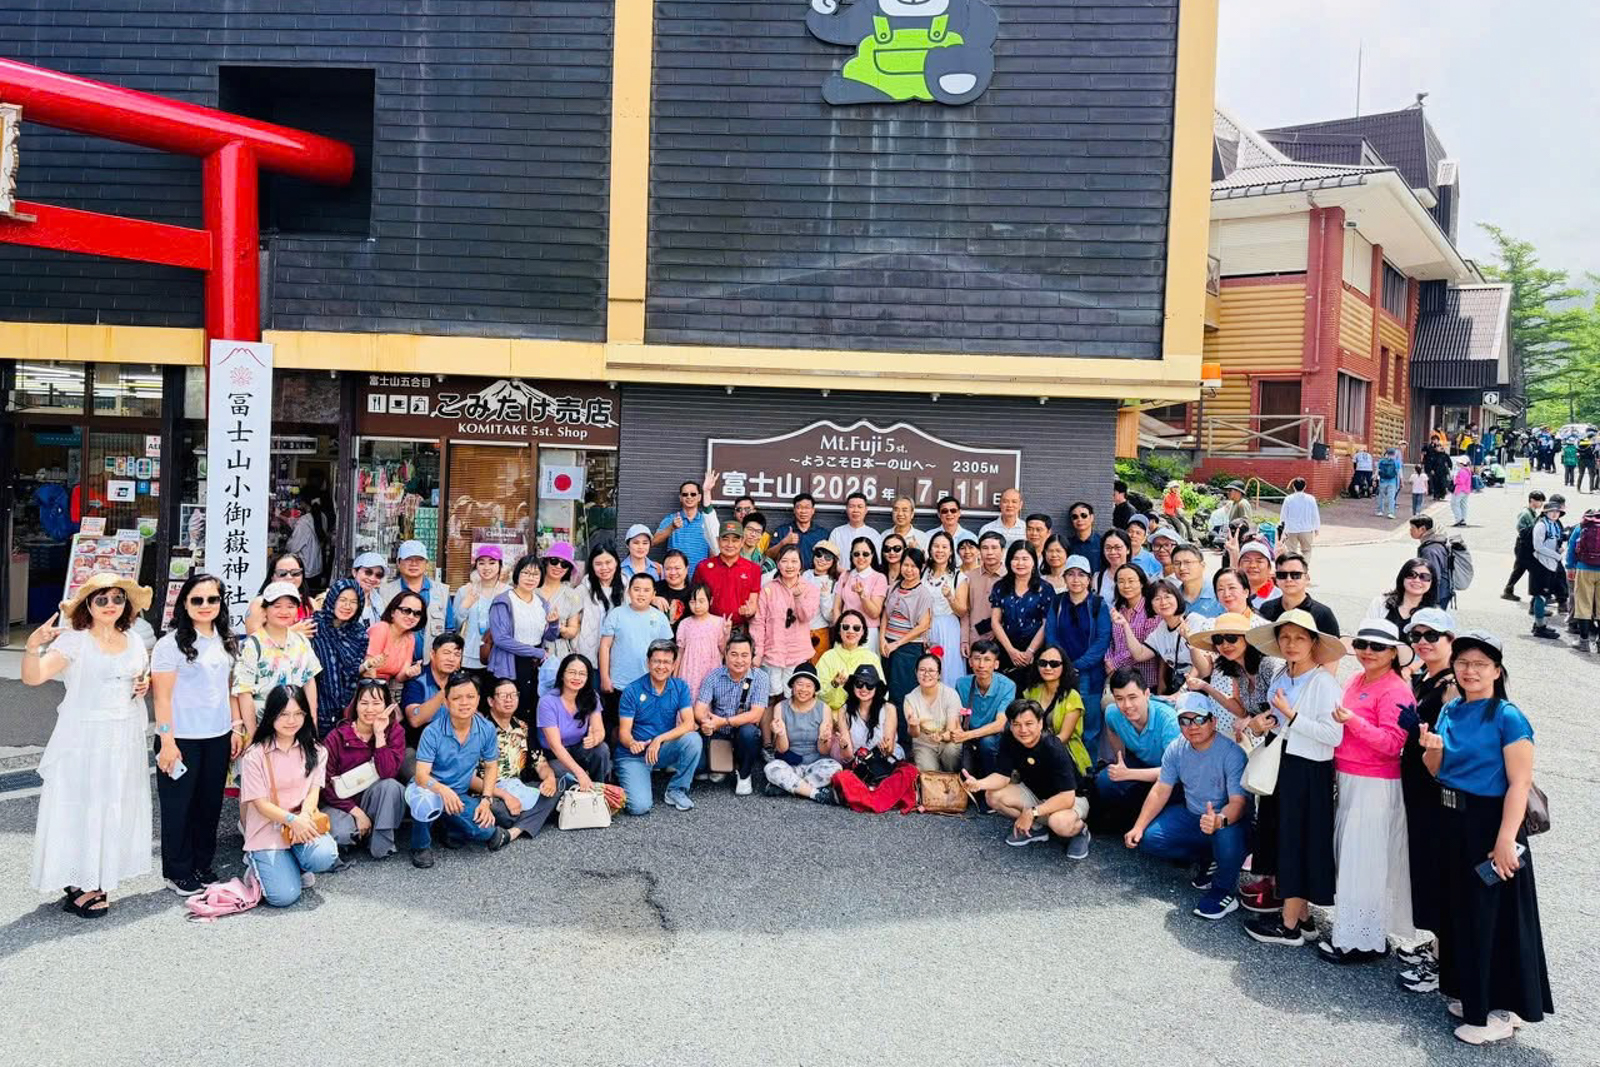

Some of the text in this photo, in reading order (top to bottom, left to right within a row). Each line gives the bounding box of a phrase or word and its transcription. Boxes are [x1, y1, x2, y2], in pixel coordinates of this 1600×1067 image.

[369, 375, 431, 388] 富士山五合目
[437, 392, 613, 425] こみたけ売店
[458, 423, 588, 441] KOMITAKE 5st. Shop
[820, 435, 882, 457] Mt.Fuji
[952, 461, 999, 474] 2305M
[721, 470, 802, 498] 富士山
